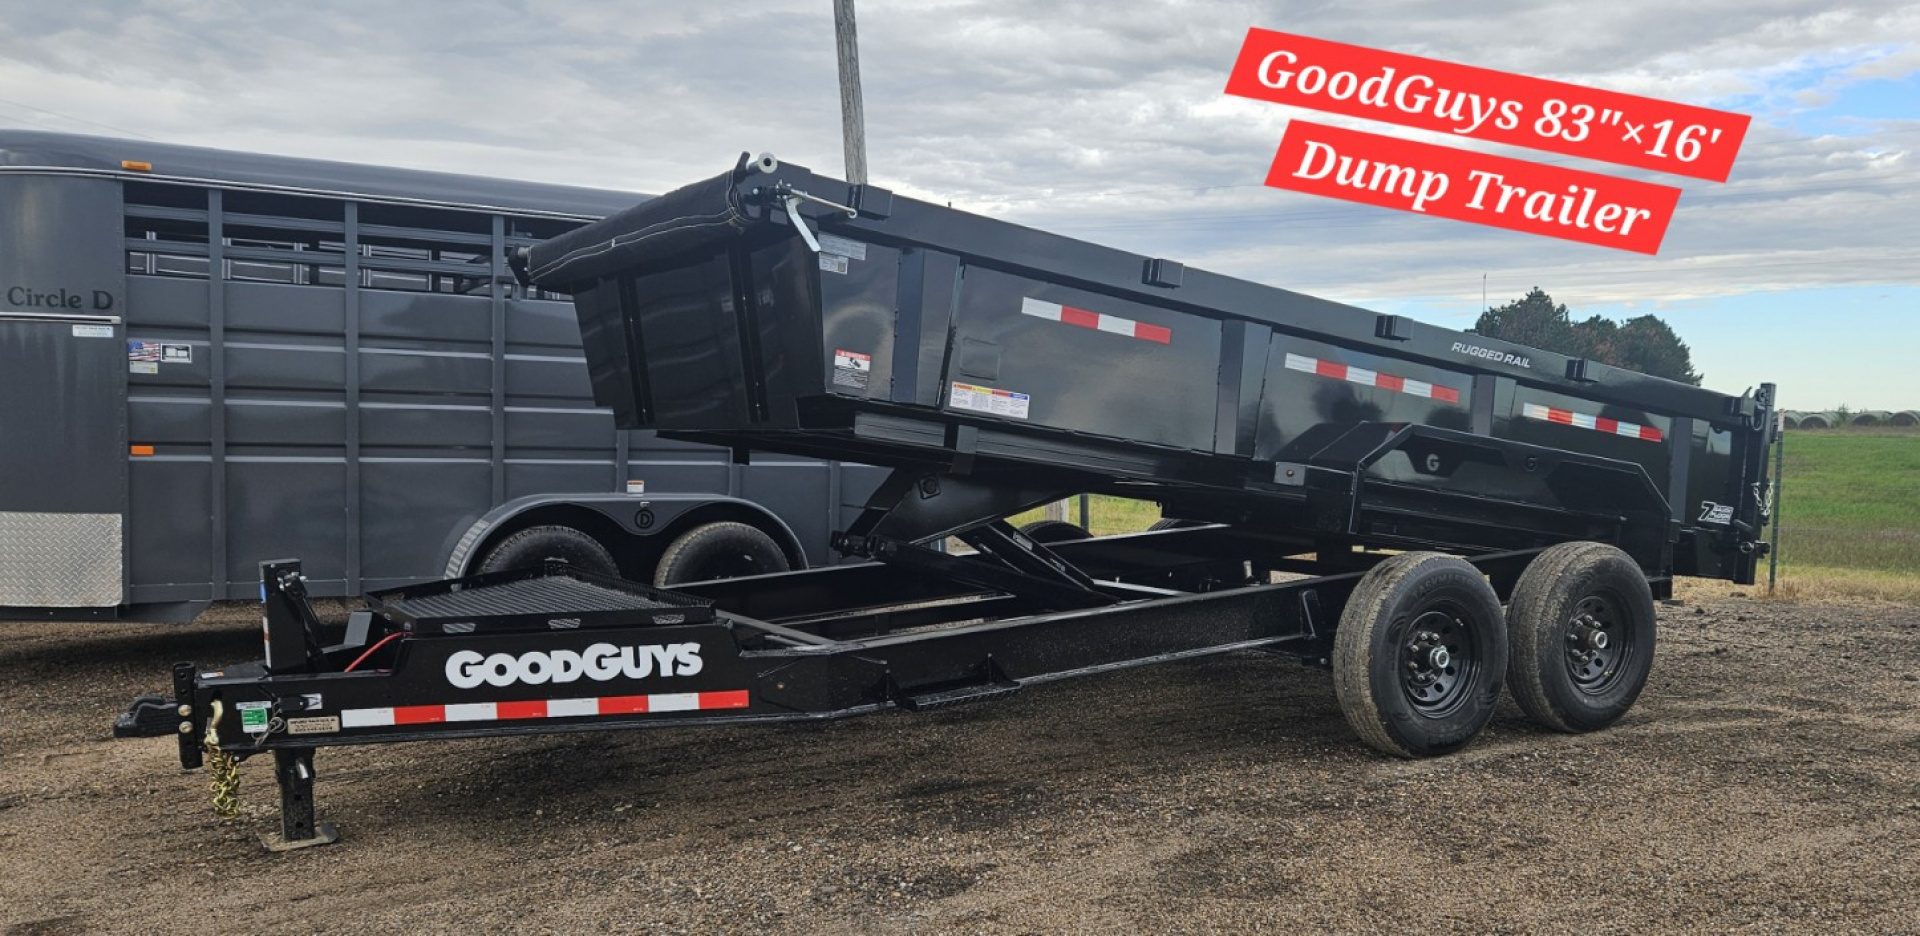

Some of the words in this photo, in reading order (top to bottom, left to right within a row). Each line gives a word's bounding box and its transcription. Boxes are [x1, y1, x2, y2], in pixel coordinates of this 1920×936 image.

[7, 286, 82, 309] Circle
[92, 289, 114, 310] D
[1451, 341, 1505, 362] RUGGED
[1503, 353, 1531, 368] RAIL
[1426, 453, 1440, 472] G
[1697, 500, 1715, 522] 7
[445, 642, 703, 689] GOODGUYS
